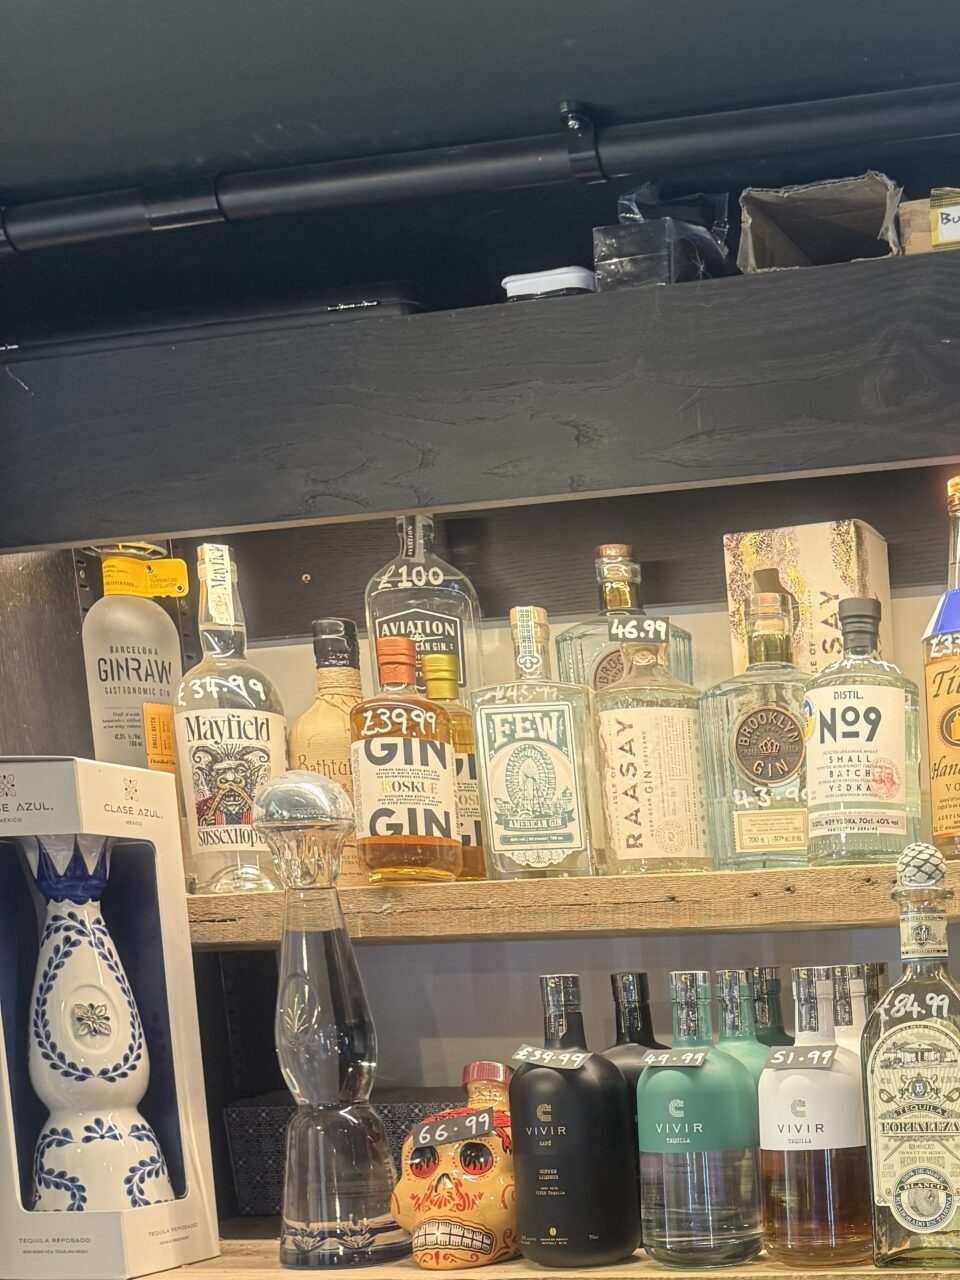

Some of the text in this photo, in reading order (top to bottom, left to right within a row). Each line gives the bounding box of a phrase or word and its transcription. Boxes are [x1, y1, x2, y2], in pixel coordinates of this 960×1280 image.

[378, 565, 444, 590] £100
[380, 620, 455, 638] AVIATION
[611, 619, 667, 641] 46.99
[109, 644, 159, 656] BARCELONA
[97, 657, 172, 686] GINRAW
[177, 675, 266, 707] £34.99
[186, 712, 271, 745] Mayfield
[361, 707, 437, 738] £39.99
[490, 712, 561, 745] FEW
[737, 712, 801, 748] BROOKLYN
[365, 739, 447, 770] GIN
[828, 754, 872, 764] SMALL
[752, 760, 790, 778] GIN
[829, 769, 871, 779] BATCH
[617, 718, 644, 849] RAASAY
[369, 807, 453, 837] GIN
[508, 817, 562, 829] AMERICAN GIN
[877, 993, 950, 1023] £84.99
[516, 1047, 585, 1066] £39.99
[644, 1051, 704, 1065] 49.99
[770, 1049, 833, 1065] 51.99
[899, 1103, 945, 1116] TEQUILA
[418, 1112, 490, 1144] 66.99
[525, 1126, 567, 1136] VIVIR
[655, 1122, 704, 1134] VIVIR
[777, 1123, 825, 1135] VIVIR
[901, 1182, 945, 1190] BLANCO
[18, 1236, 91, 1245] TEQUILA REPOSADO
